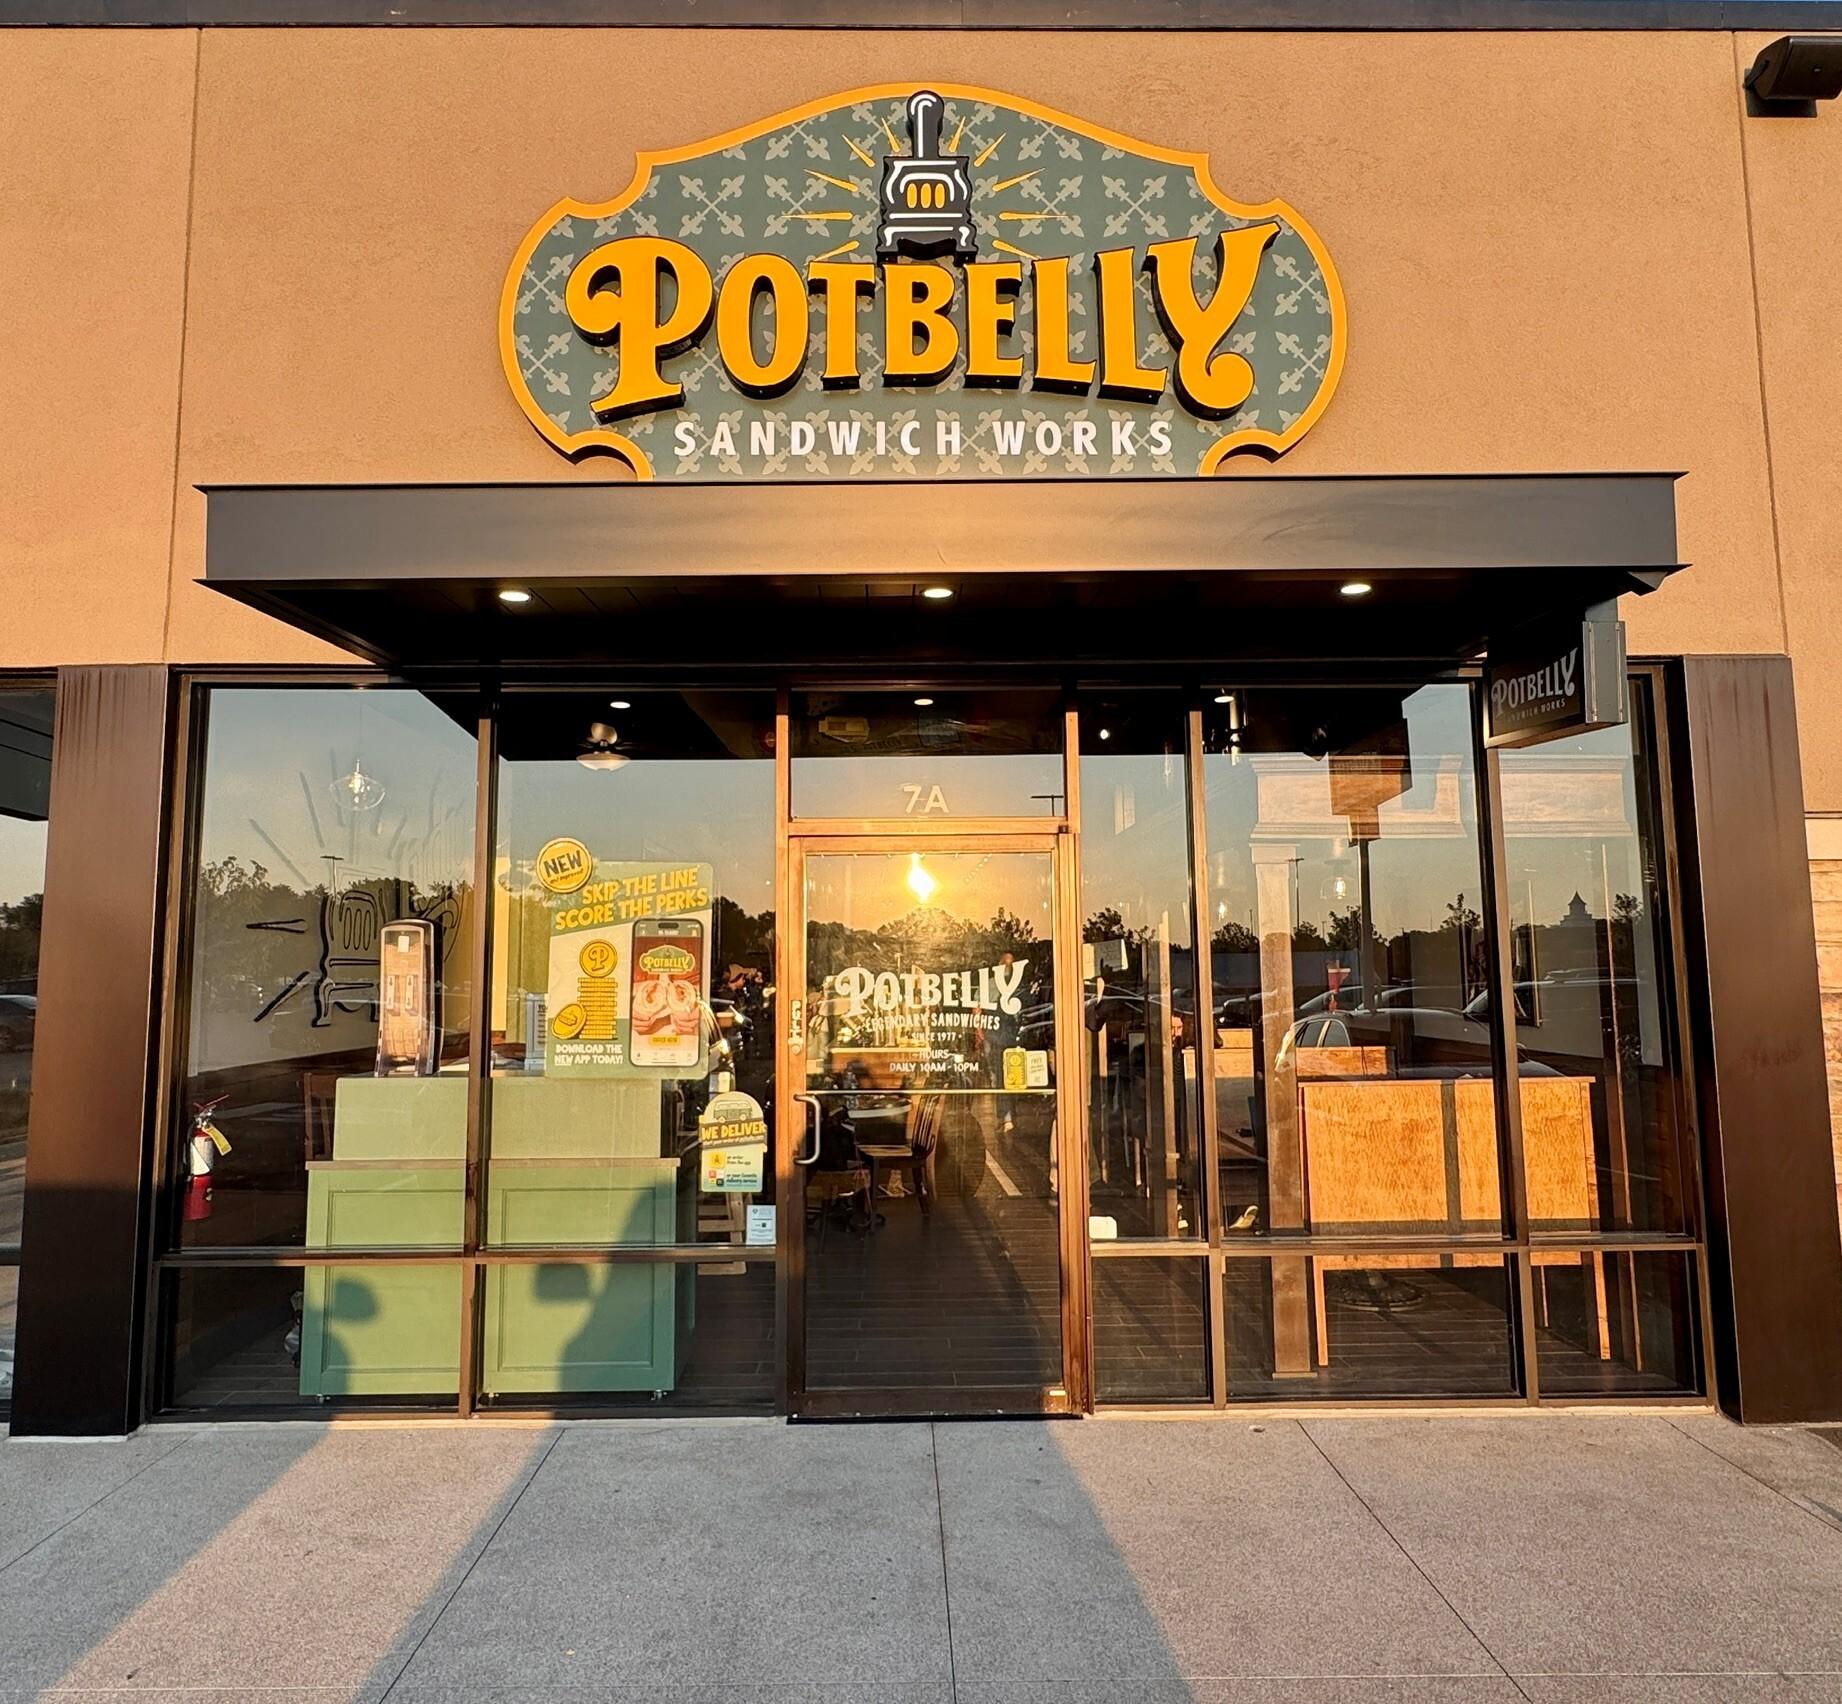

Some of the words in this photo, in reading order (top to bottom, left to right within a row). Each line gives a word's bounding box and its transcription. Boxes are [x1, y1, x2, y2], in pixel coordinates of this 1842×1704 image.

[564, 221, 1282, 414] POTBELLY
[673, 419, 963, 458] SANDWICH
[996, 419, 1174, 458] WORKS
[1491, 647, 1578, 719] POTBELLY
[903, 784, 950, 813] 7A
[543, 850, 583, 878] NEW
[582, 880, 619, 905] SKIP
[622, 874, 657, 897] THE
[661, 866, 699, 892] LINE
[555, 903, 615, 930] SCORE
[618, 896, 653, 919] THE
[656, 887, 708, 914] PERKS
[834, 959, 1029, 1016] POTBELLY
[865, 1013, 928, 1032] LEGENDARY
[931, 1012, 1000, 1030] SANDWICHES
[555, 1044, 604, 1054] DOWNLOAD
[605, 1044, 623, 1054] THE
[937, 1032, 956, 1041] 1977
[554, 1055, 573, 1065] NEW
[574, 1055, 591, 1064] APP
[889, 1062, 916, 1072] DAILY
[920, 1062, 946, 1072] 10AM
[953, 1062, 979, 1072] 10PM
[701, 1126, 720, 1141] WE
[720, 1121, 765, 1138] DELIVER
